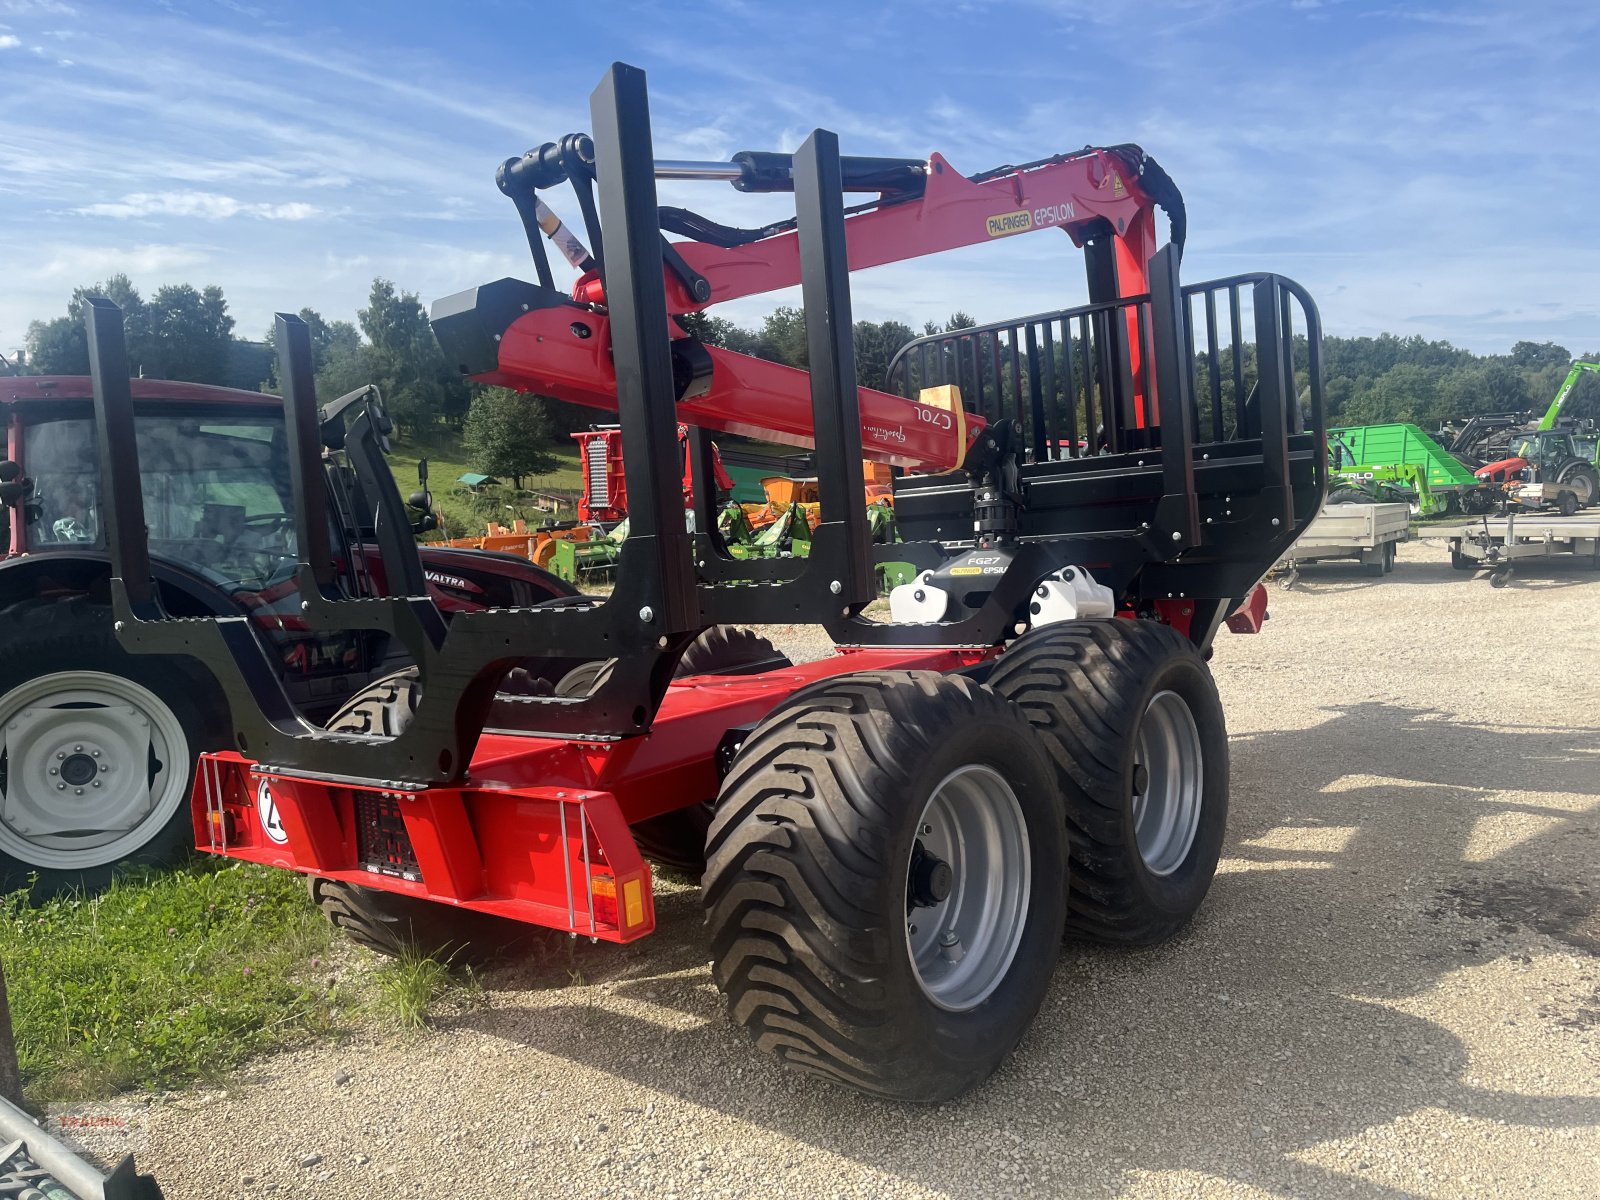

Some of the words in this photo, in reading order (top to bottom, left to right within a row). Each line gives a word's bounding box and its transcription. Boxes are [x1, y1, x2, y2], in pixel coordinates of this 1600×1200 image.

[988, 213, 1030, 233] PALFINGER
[1034, 202, 1075, 225] EPSILON
[913, 406, 952, 430] C70L
[967, 557, 1000, 565] FG27
[424, 570, 465, 588] VALTRA
